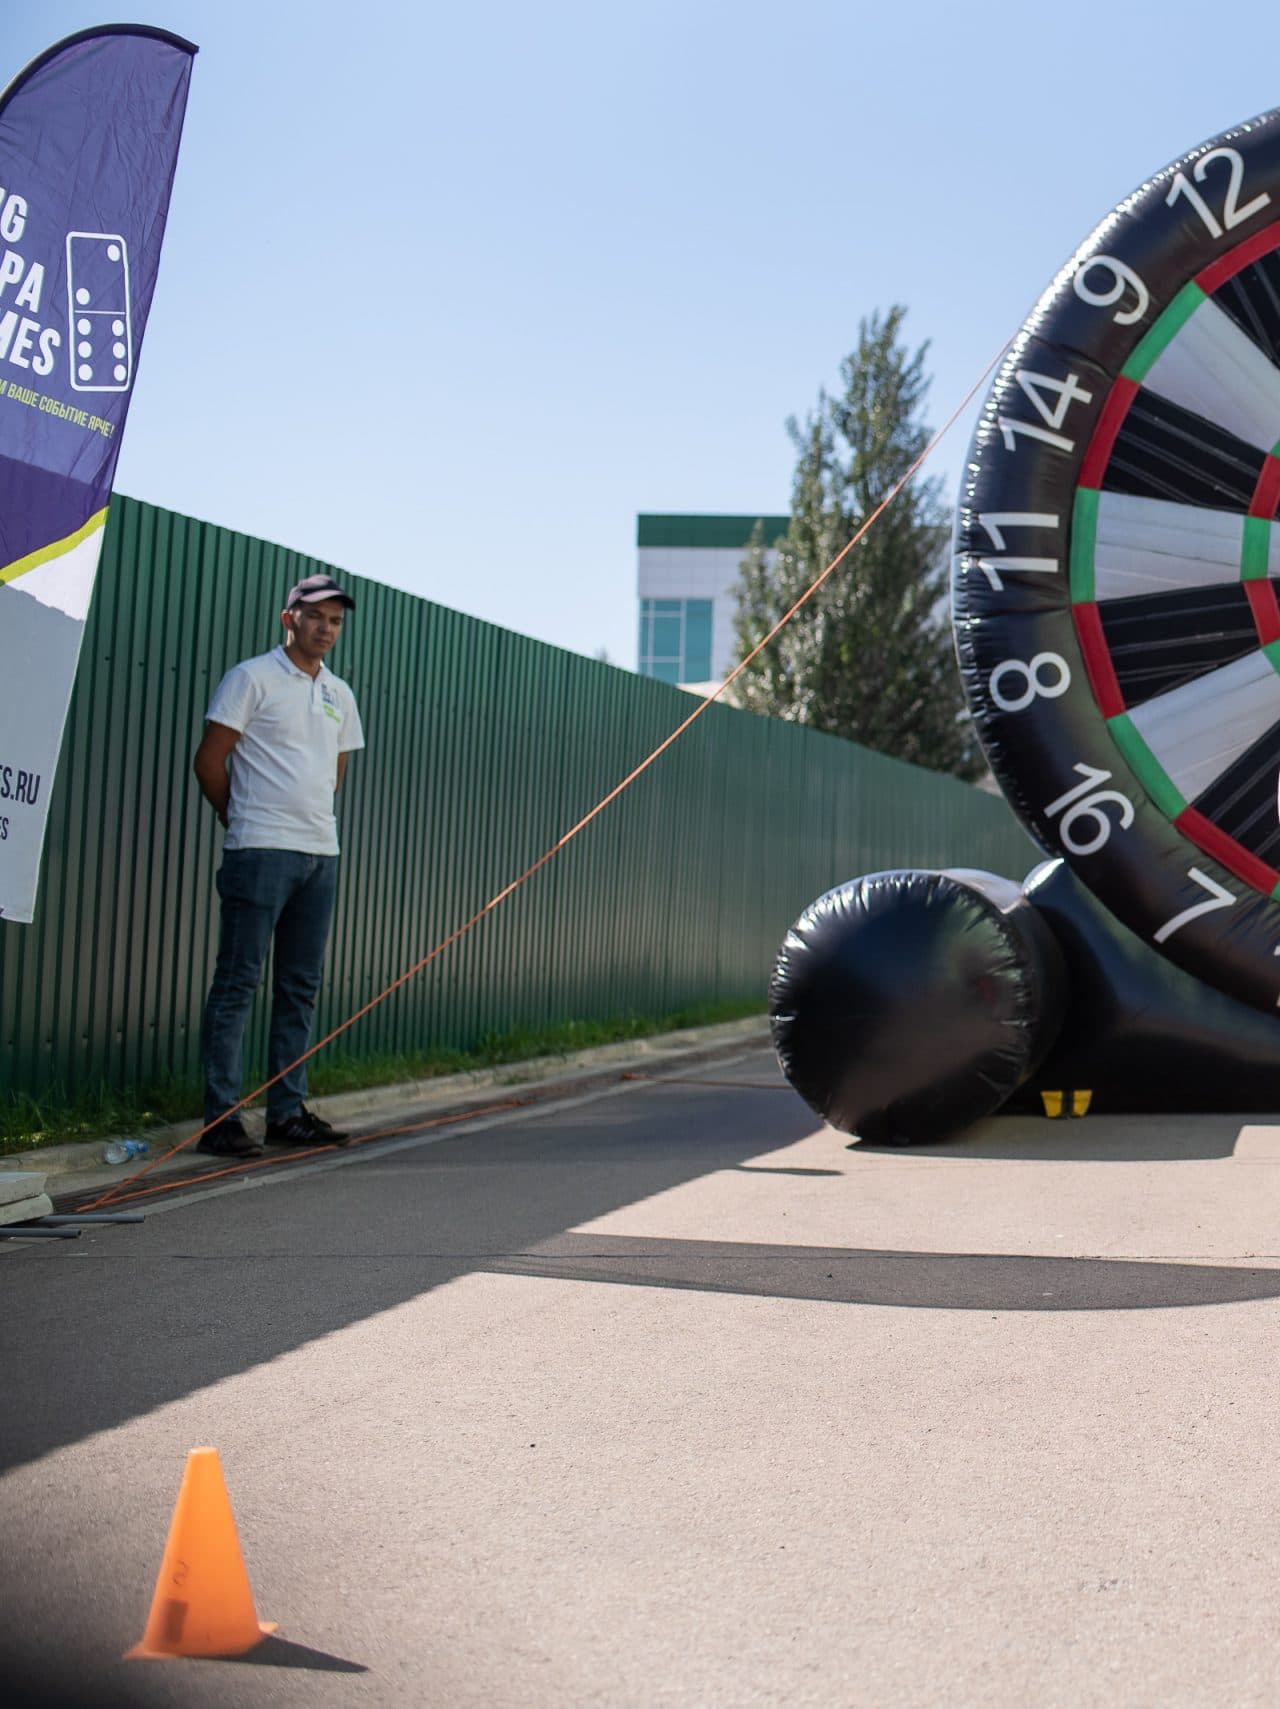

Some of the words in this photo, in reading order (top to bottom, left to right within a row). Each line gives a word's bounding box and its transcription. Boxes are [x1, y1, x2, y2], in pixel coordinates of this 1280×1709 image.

[0, 187, 28, 242] G
[1165, 146, 1272, 240] 12
[1072, 254, 1151, 326] 9
[7, 383, 40, 408] ВАШЕ
[39, 395, 89, 427] СОБЫТИЕ
[997, 369, 1093, 454] 14
[977, 512, 1060, 592] 11
[989, 651, 1072, 714] 8
[0, 765, 41, 805] S.RU
[1043, 761, 1135, 857] 16
[0, 816, 9, 841] S
[1152, 866, 1238, 944] 7
